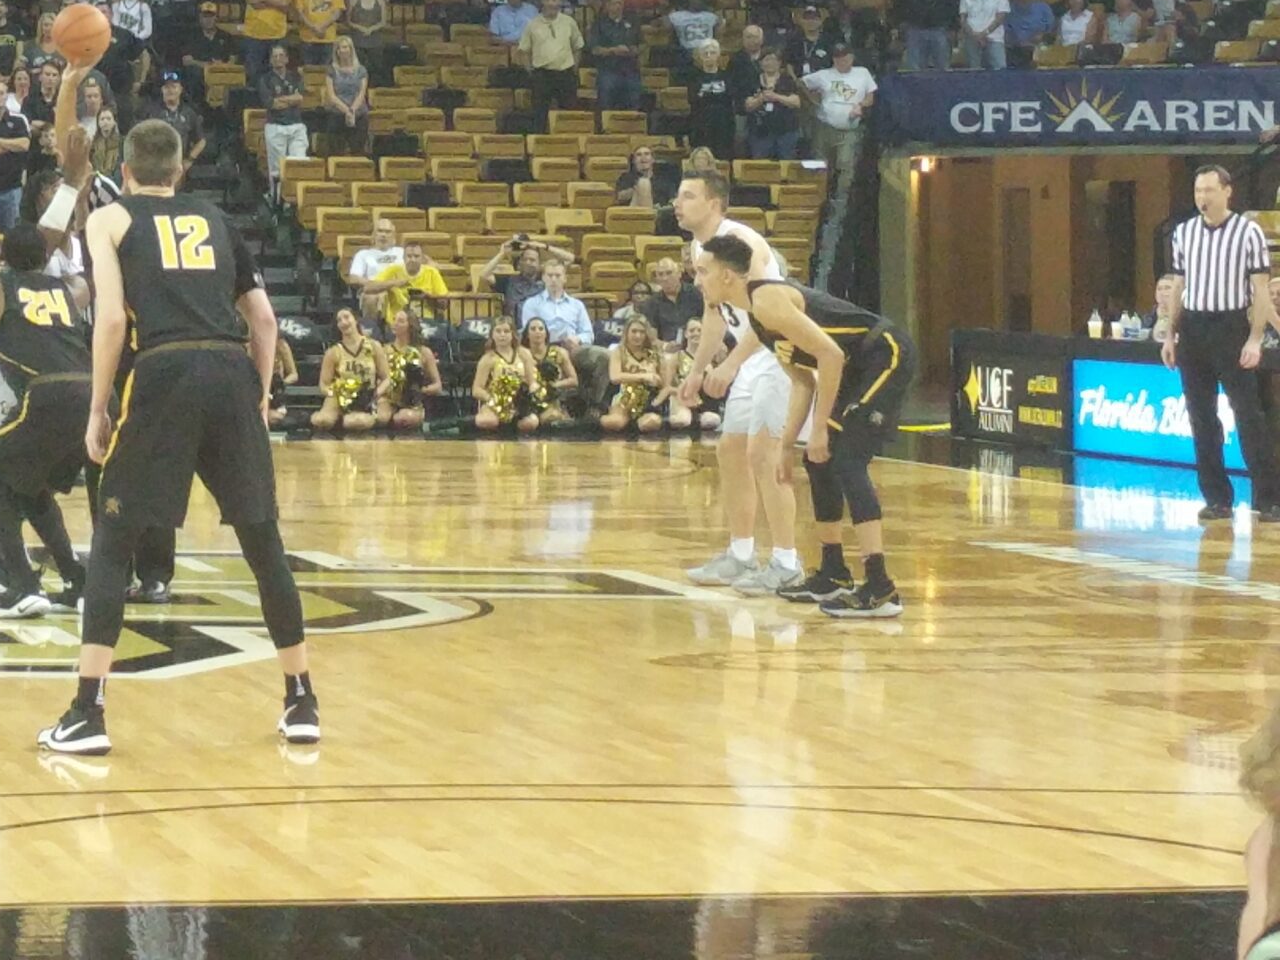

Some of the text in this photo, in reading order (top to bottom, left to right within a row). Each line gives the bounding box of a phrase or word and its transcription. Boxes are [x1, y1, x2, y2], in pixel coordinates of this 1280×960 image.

[950, 100, 1275, 133] CFE AREN
[153, 215, 216, 270] 12
[18, 287, 75, 327] 24
[977, 366, 1014, 409] UCF
[978, 411, 1013, 433] ALUMNI
[1080, 384, 1157, 434] Florida
